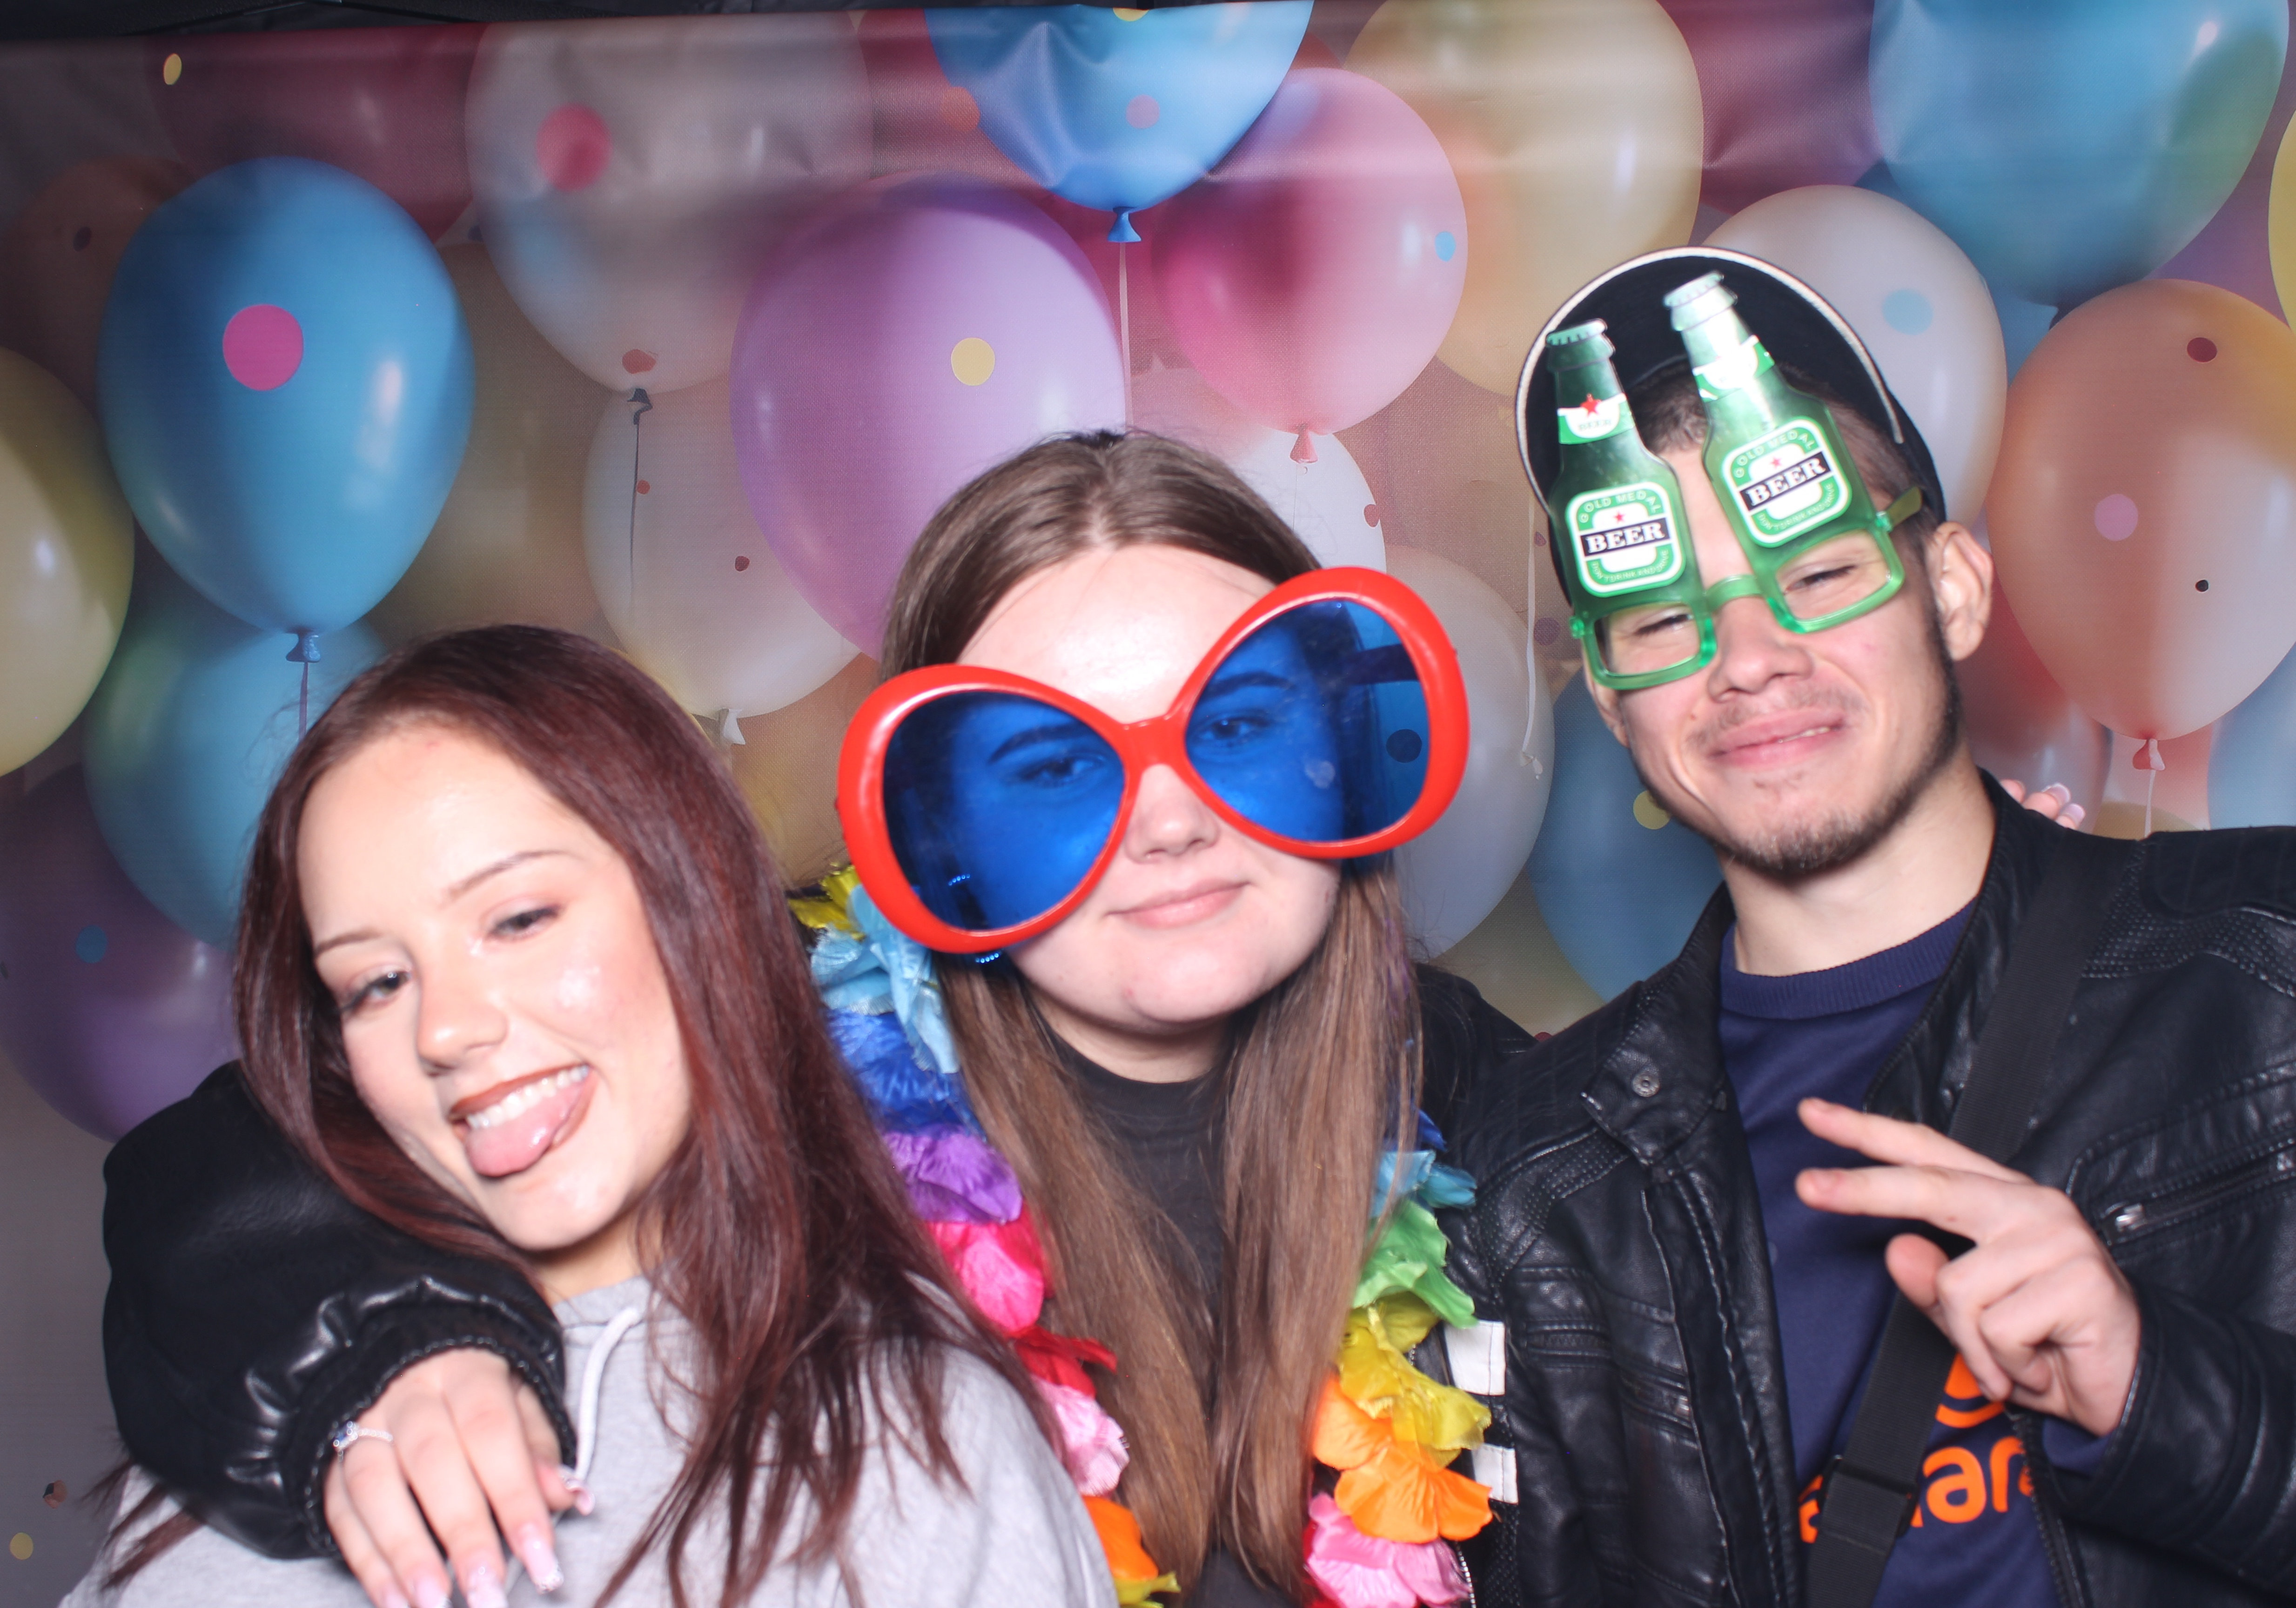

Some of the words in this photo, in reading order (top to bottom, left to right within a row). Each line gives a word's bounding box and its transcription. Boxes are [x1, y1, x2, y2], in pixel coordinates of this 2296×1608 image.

[1733, 448, 1765, 478] GOLD
[1768, 430, 1815, 449] MEDAL
[1745, 457, 1826, 506] BEER
[1579, 497, 1611, 523] GOLD
[1616, 490, 1661, 513] MEDAL
[1585, 523, 1665, 553] BEER
[1610, 571, 1636, 583] DRINK
[1638, 567, 1656, 576] AND
